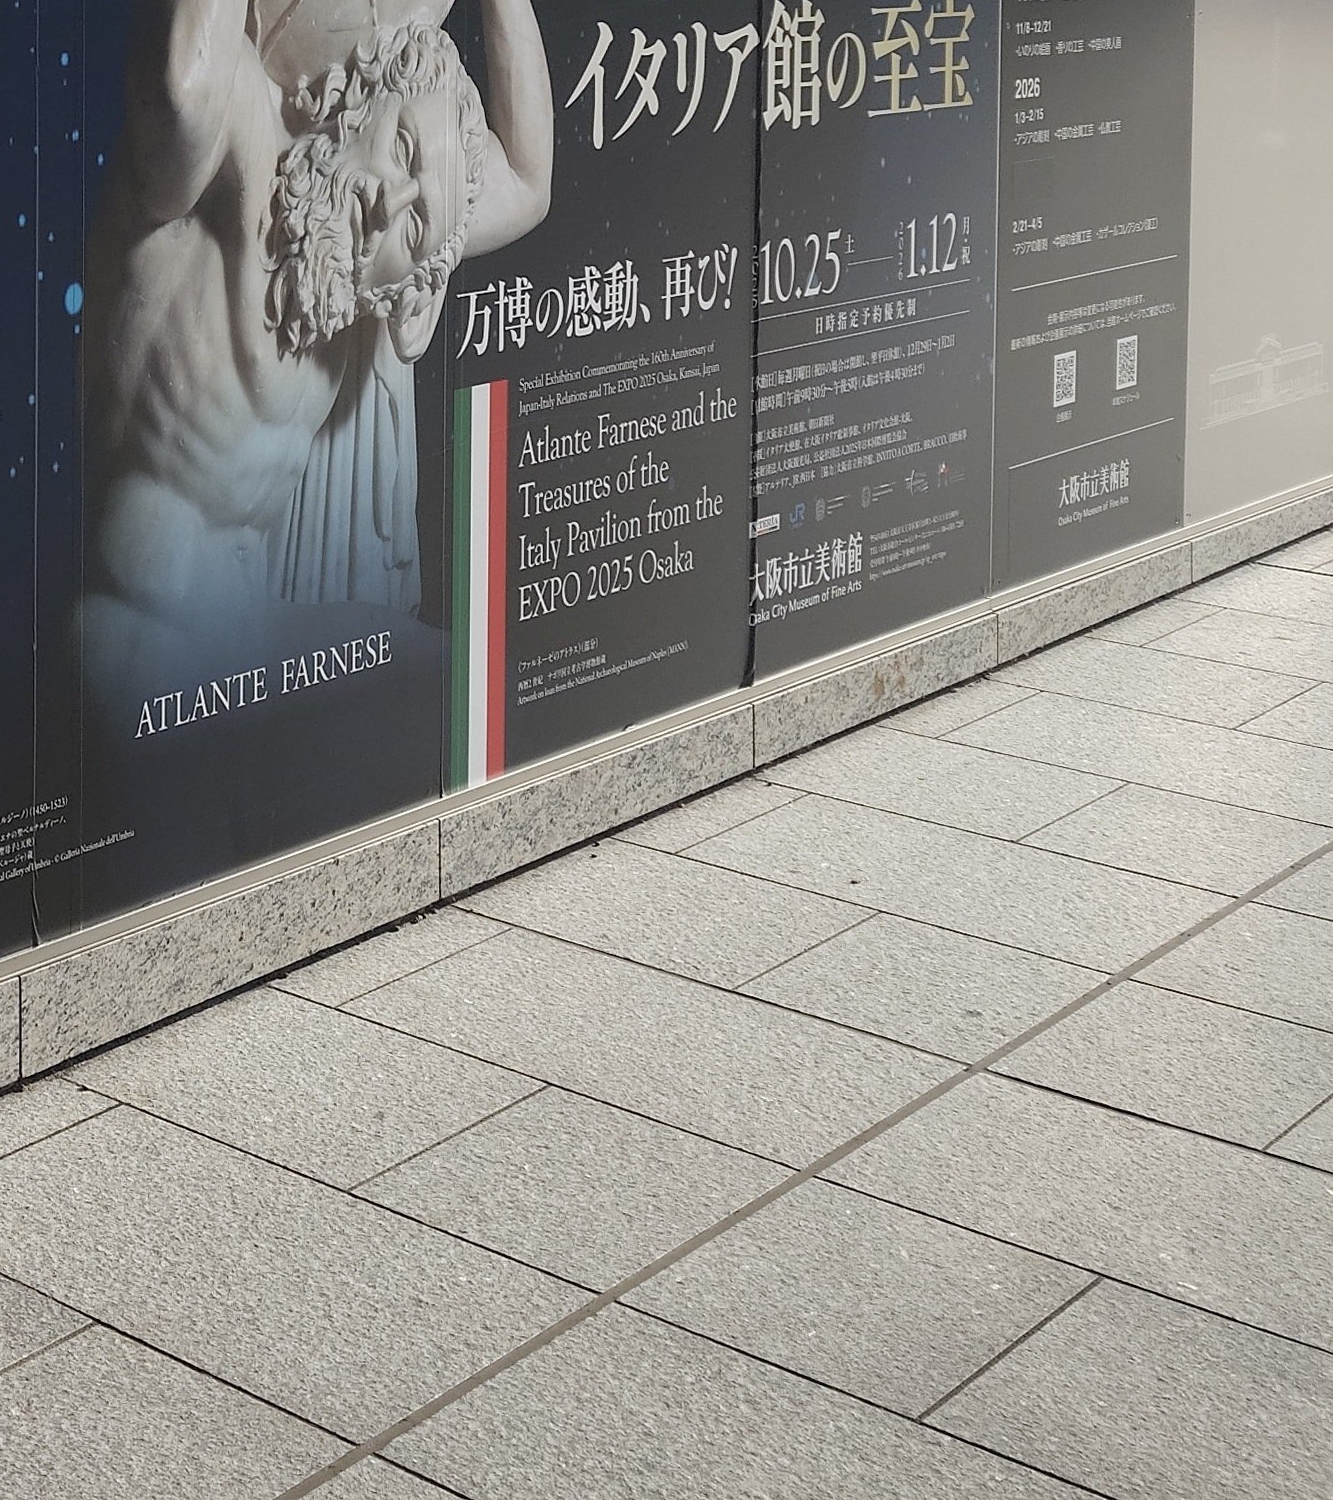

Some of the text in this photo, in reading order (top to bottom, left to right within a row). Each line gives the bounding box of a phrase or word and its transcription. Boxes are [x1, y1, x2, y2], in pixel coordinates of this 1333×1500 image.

[1015, 77, 1041, 100] 2026
[760, 227, 855, 305] 10.25 土
[906, 211, 959, 279] 1.12
[815, 297, 917, 335] 日時指定予約優先制
[519, 373, 544, 393] Special
[545, 368, 581, 387] Exhibition
[582, 358, 638, 379] Commemorating
[639, 354, 650, 367] the
[670, 345, 707, 362] Anniversary
[707, 340, 716, 353] of
[518, 395, 555, 417] Japan-Italy
[556, 390, 587, 406] Relations
[588, 386, 601, 399] and
[603, 382, 617, 396] The
[617, 376, 639, 393] EXPO
[518, 425, 592, 468] Atlante
[597, 413, 667, 449] Farnese
[672, 391, 704, 431] and
[710, 387, 738, 422] the
[518, 451, 670, 518] Treasures of the
[1058, 458, 1130, 509] 大阪市立美術館
[518, 485, 724, 571] Italy Pavilion from the
[789, 502, 806, 524] JR
[1058, 514, 1072, 526] Osaka
[1073, 511, 1082, 522] City
[1083, 505, 1102, 517] Museum
[1103, 500, 1109, 511] of
[1109, 498, 1119, 508] Fine
[518, 540, 695, 622] EXPO 2025 Osaka
[749, 531, 863, 606] 大阪市立美術館
[749, 580, 862, 626] Oaka City Museum of Fine Arts
[134, 631, 393, 739] ATLANTE FARNESE
[5, 866, 24, 881] Gallery
